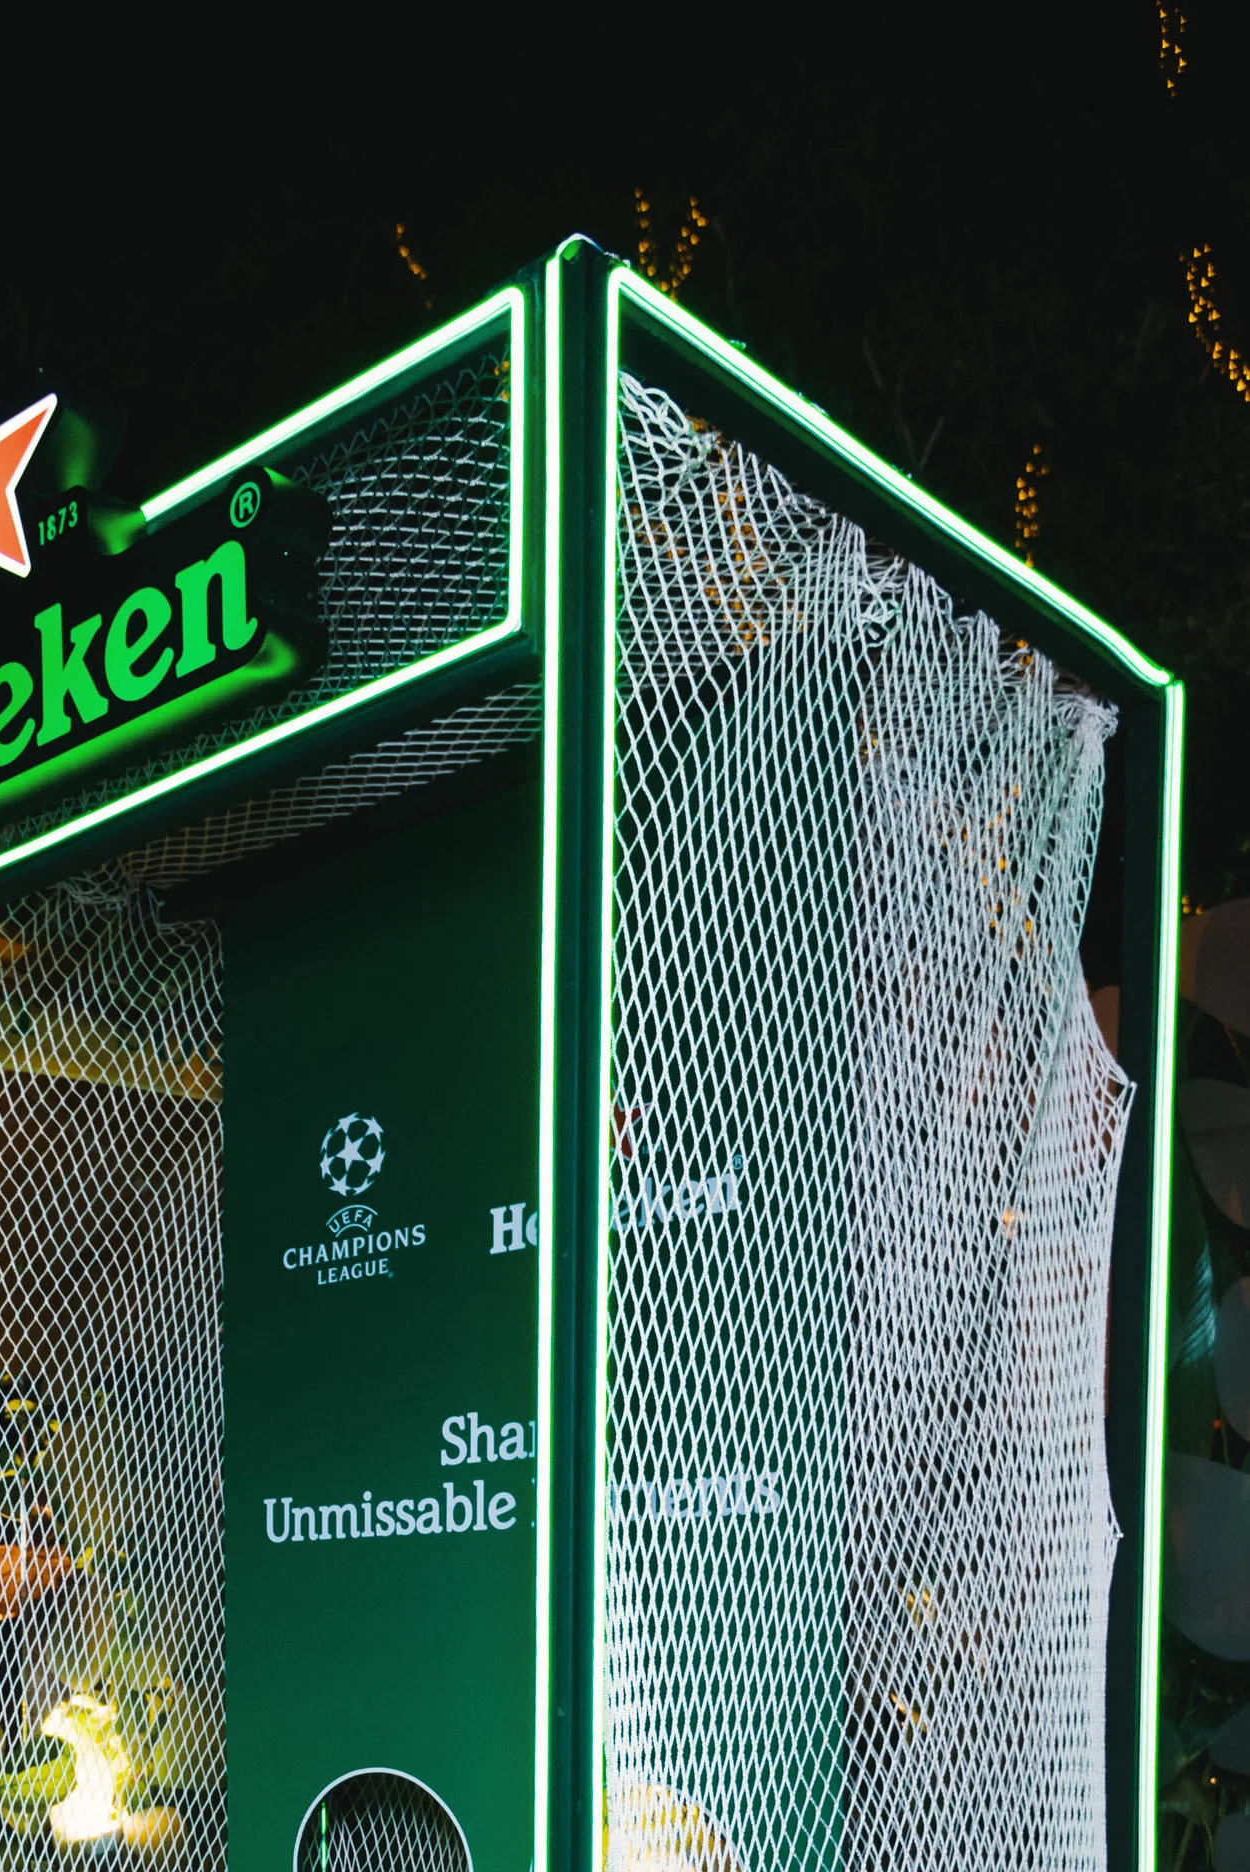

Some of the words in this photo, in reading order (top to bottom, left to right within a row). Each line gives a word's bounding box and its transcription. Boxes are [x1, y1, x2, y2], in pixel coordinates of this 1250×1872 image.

[37, 500, 79, 546] 1873
[328, 1208, 373, 1233] UEFA
[282, 1223, 426, 1270] CHAMPIONS
[317, 1257, 389, 1286] LEAGUE
[263, 1480, 517, 1543] Unmissable
